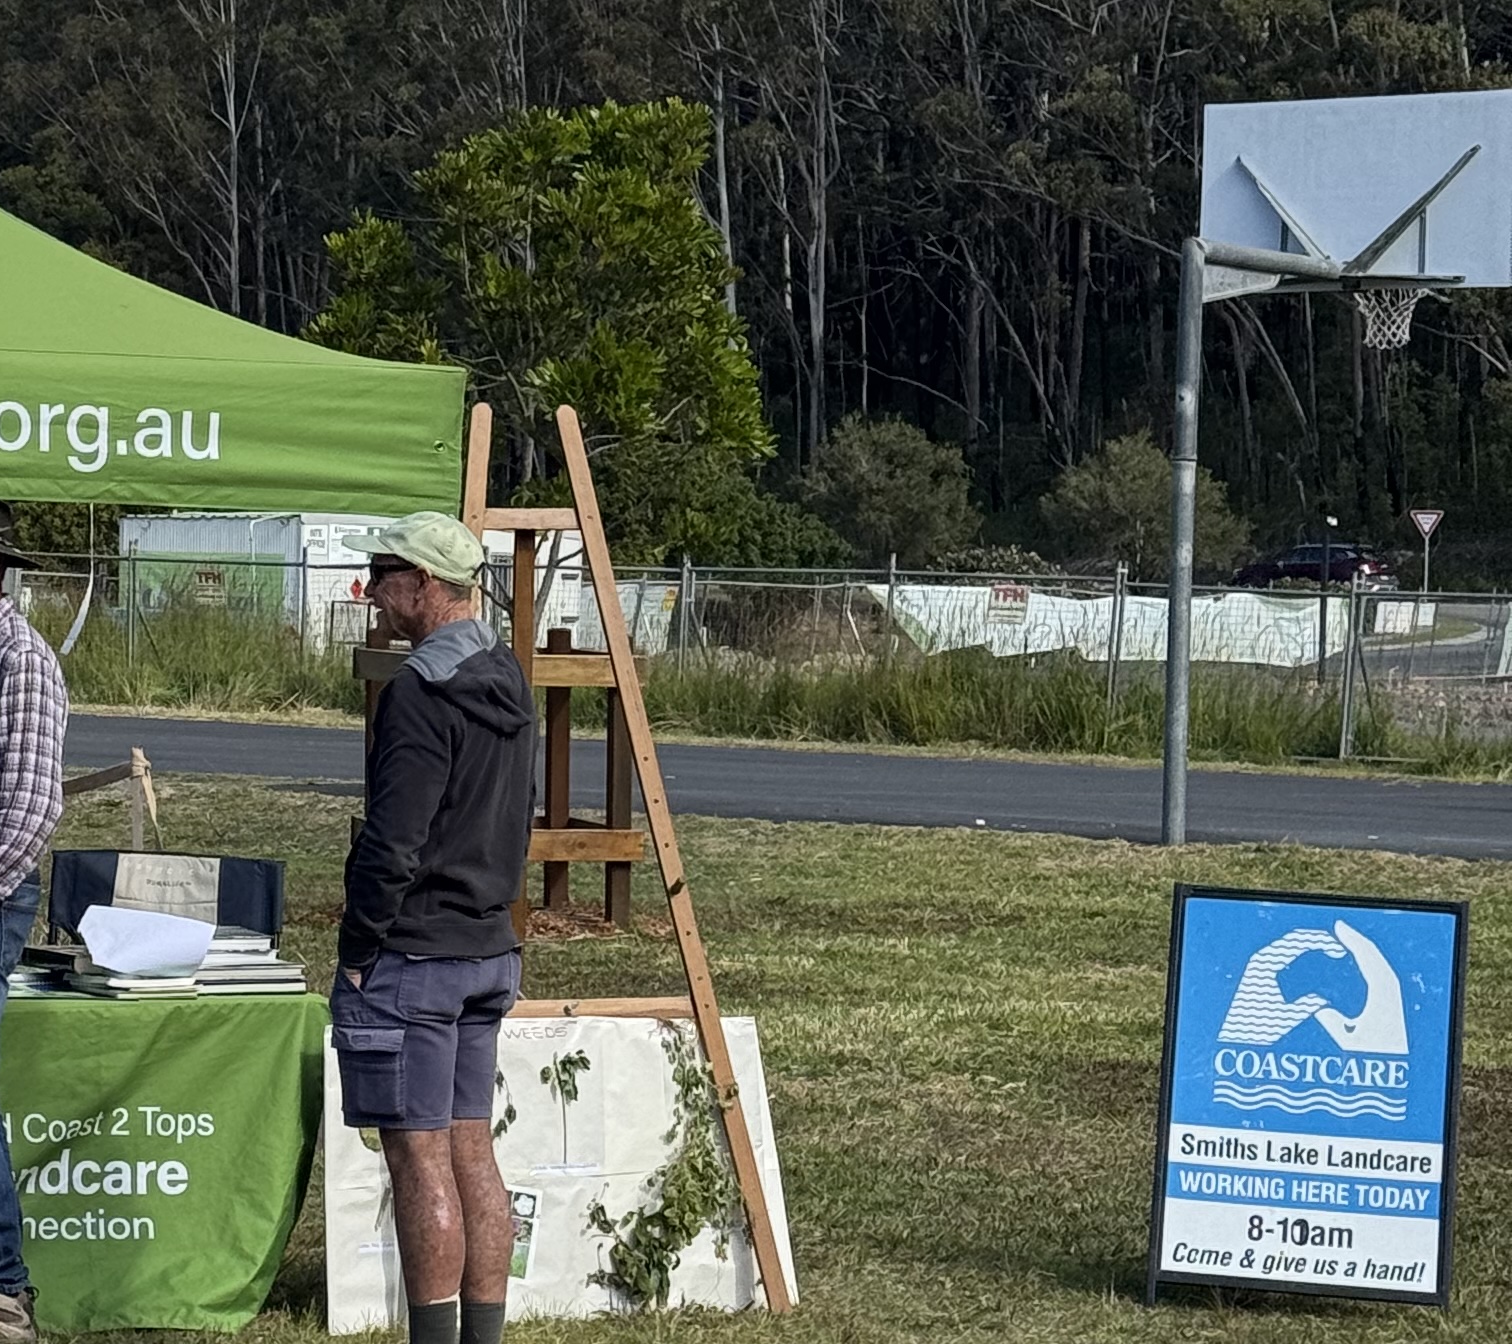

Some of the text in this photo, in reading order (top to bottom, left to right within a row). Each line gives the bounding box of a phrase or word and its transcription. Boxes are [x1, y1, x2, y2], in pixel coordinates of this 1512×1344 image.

[503, 1026, 568, 1040] WEEDS
[1214, 1048, 1410, 1089] COASTCARE
[22, 1110, 105, 1144] Coast
[110, 1107, 130, 1136] 2
[137, 1106, 215, 1144] Tops
[11, 1148, 189, 1195] ndcare
[1180, 1133, 1432, 1174] Smiths Lake Landcare
[1179, 1169, 1430, 1211] WORKING HERE TODAY
[1172, 1242, 1427, 1284] Come & give us a hand!
